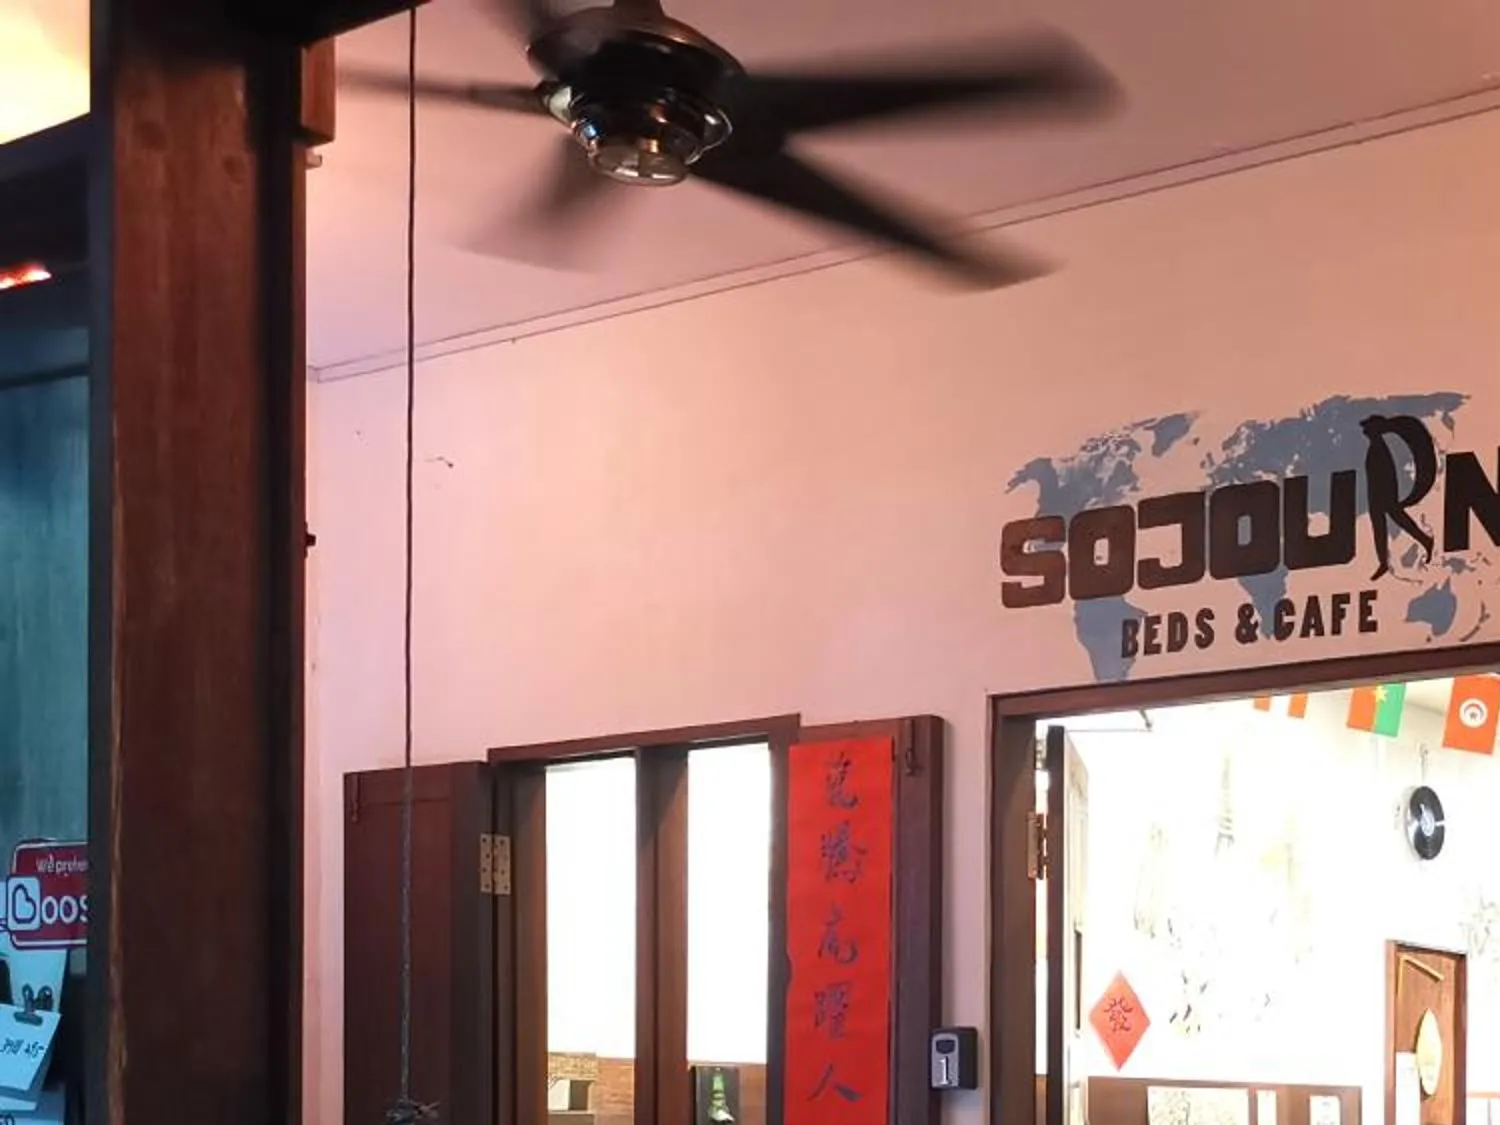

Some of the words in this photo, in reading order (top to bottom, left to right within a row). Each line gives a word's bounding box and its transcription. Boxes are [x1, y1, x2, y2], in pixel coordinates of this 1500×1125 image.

[1121, 607, 1215, 659] BEDS
[1235, 602, 1259, 645] &
[1273, 589, 1378, 642] CAFE
[940, 1056, 952, 1086] 1
